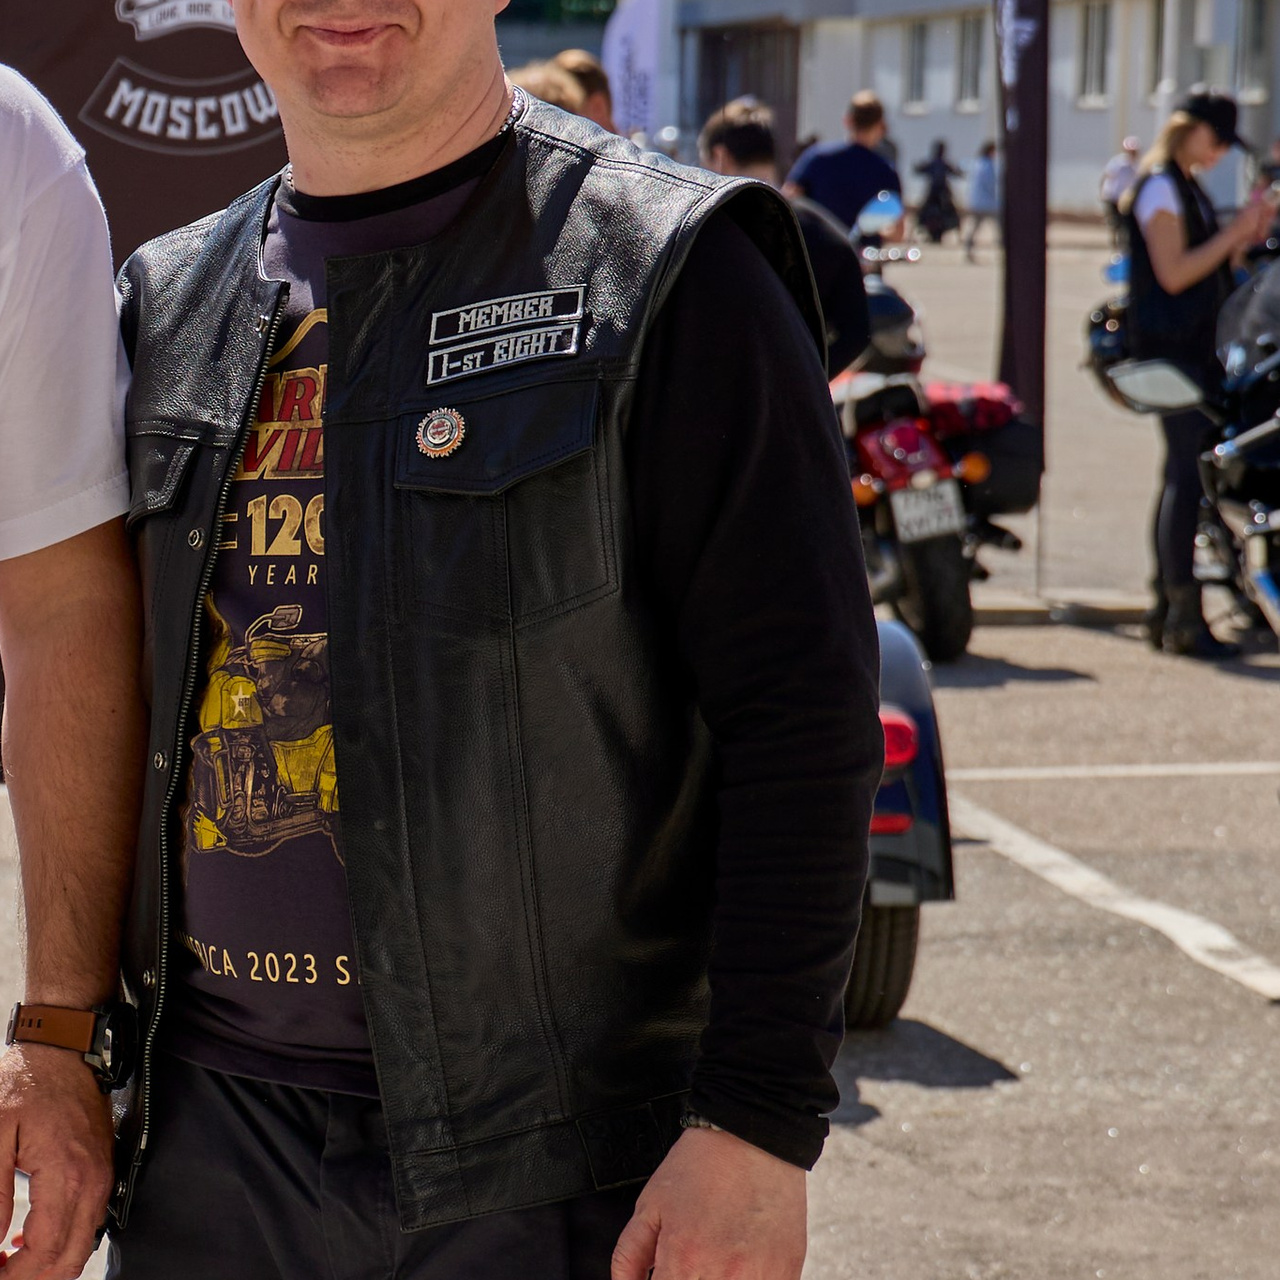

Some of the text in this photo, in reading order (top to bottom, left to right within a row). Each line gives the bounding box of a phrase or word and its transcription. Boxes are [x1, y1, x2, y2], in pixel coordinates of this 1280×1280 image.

[104, 78, 278, 140] MOSCOW
[457, 295, 555, 334] MEMBER
[493, 330, 564, 365] EIGHT
[247, 951, 318, 984] 2023
[335, 955, 361, 985] S
